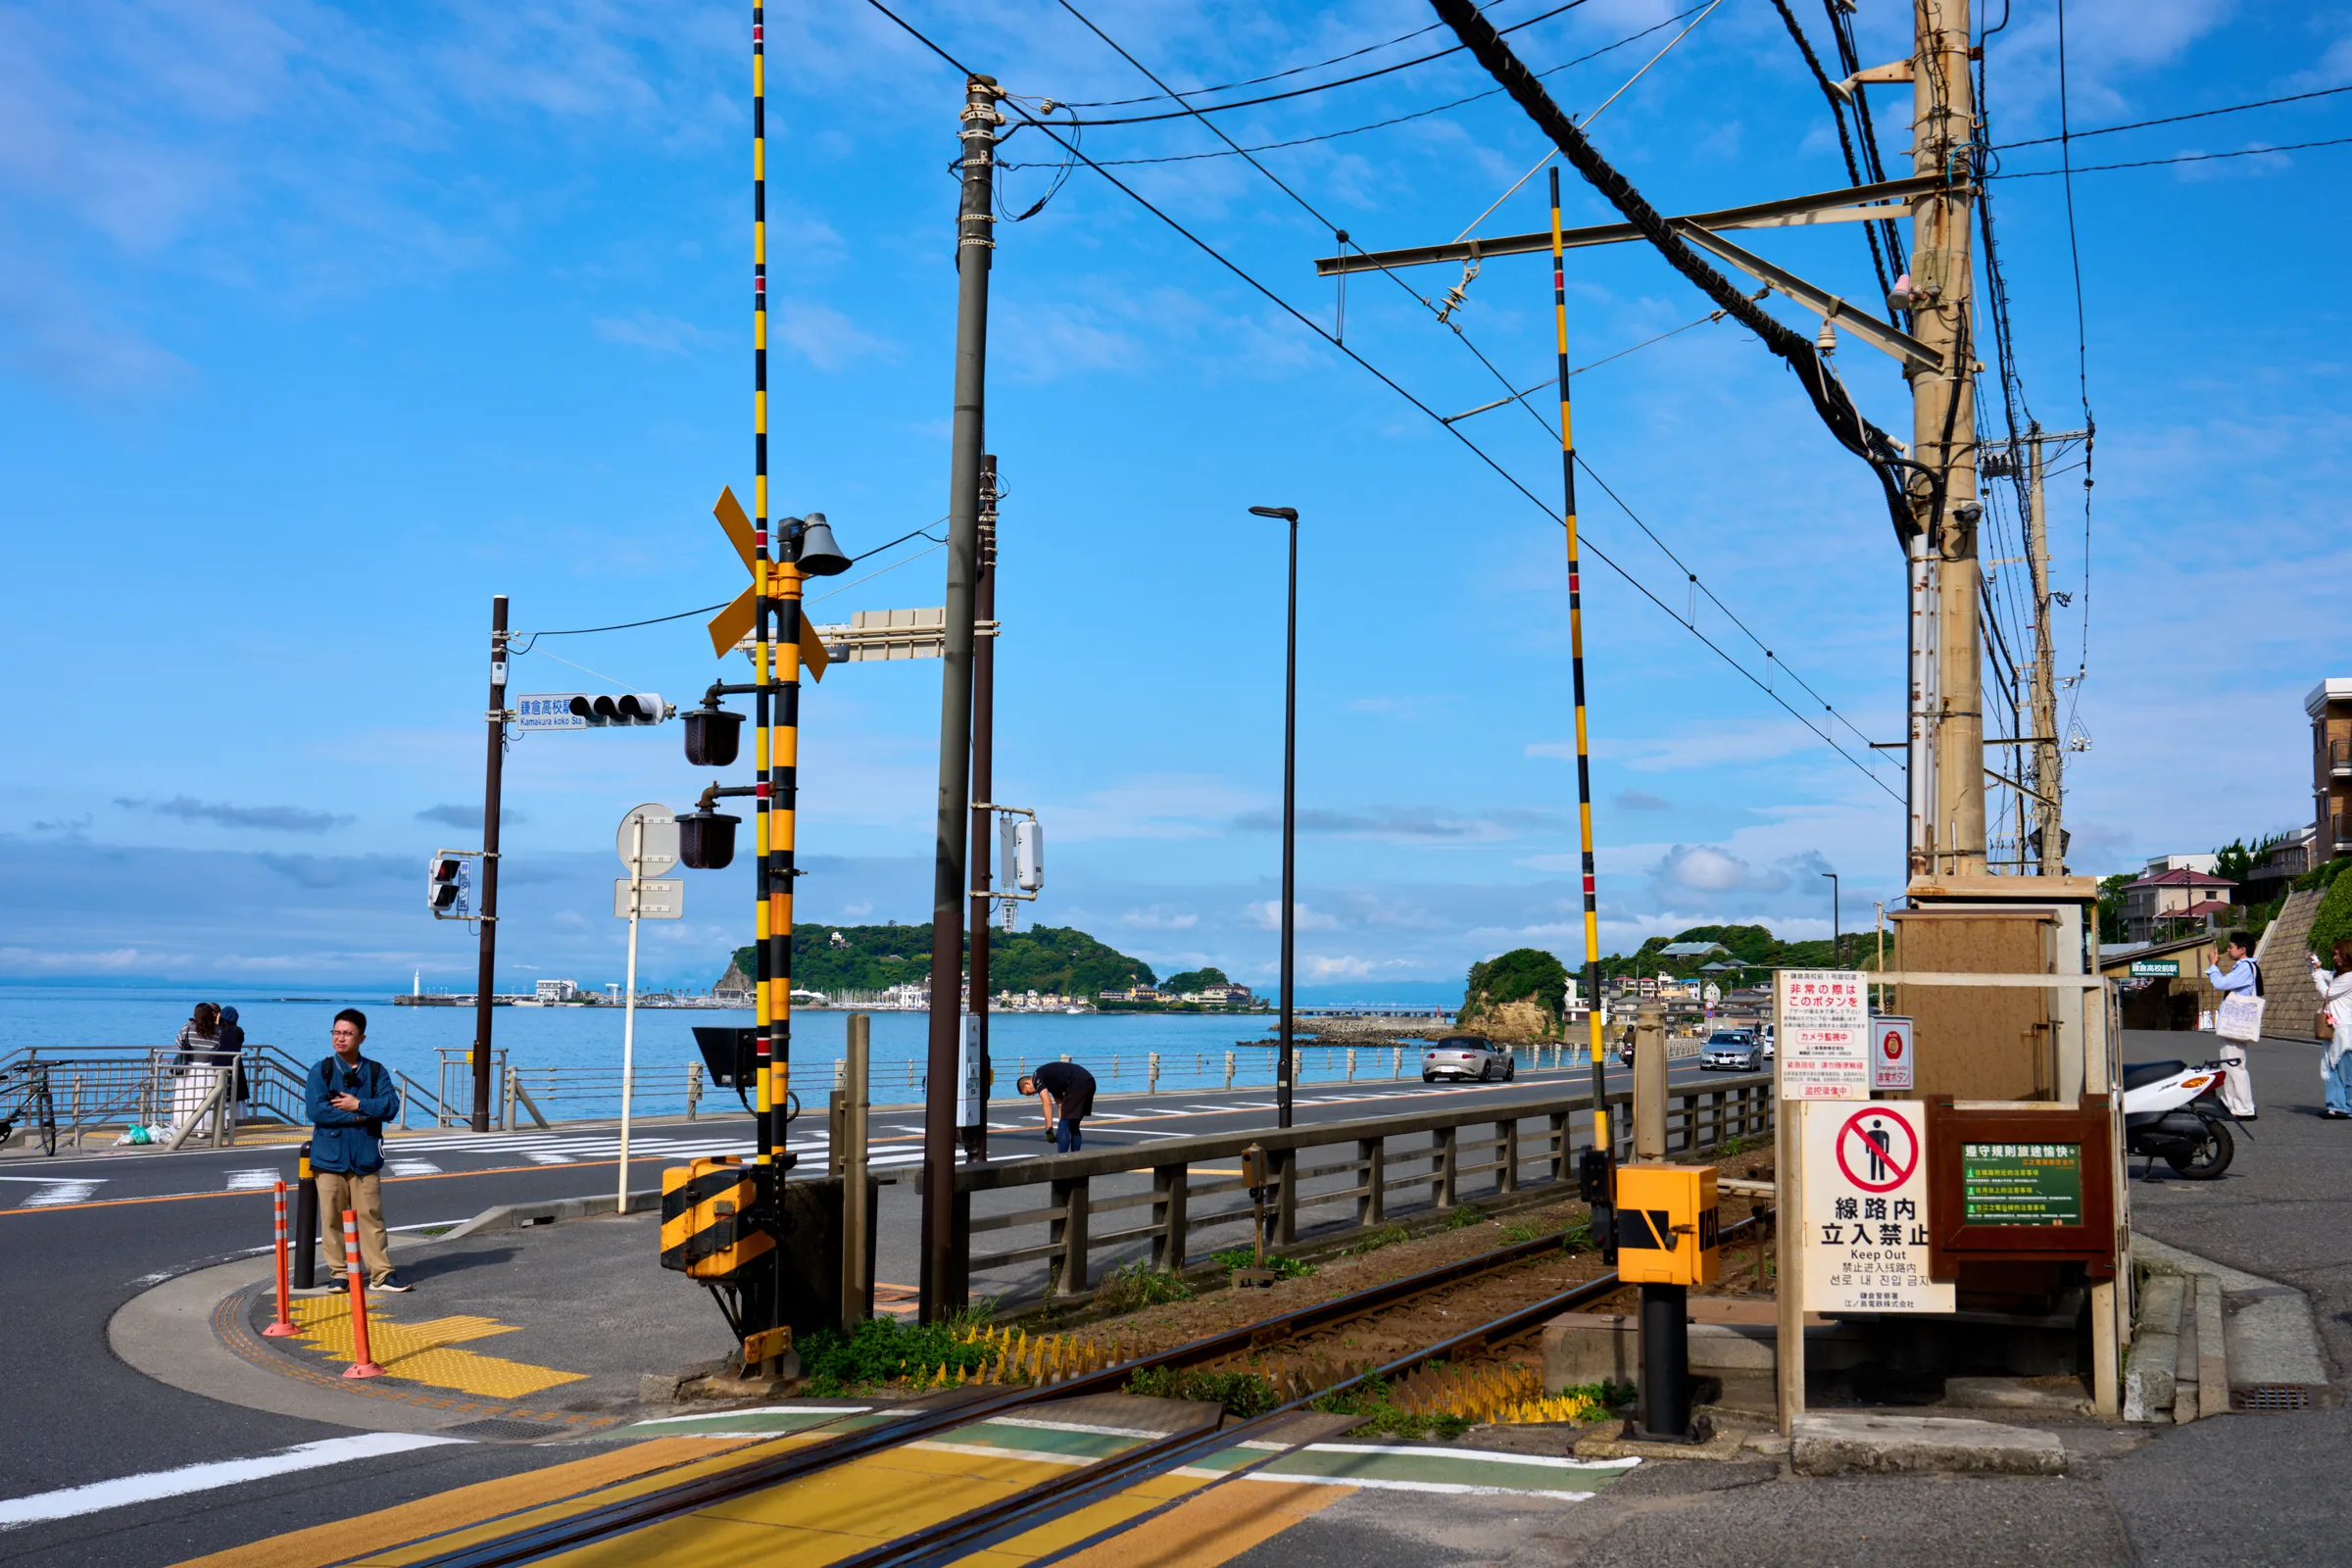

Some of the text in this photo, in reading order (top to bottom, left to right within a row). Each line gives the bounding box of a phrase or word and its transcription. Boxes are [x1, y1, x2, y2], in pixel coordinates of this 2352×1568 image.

[520, 700, 571, 714] 鎌倉高校駅
[1790, 984, 1856, 995] 非常の際は
[1789, 997, 1858, 1007] このボタンを
[1878, 1072, 1909, 1083] 非常ボタン
[1805, 1086, 1847, 1095] 监控录像中
[1965, 1145, 2076, 1157] 遵守規則旅途愉快。
[1836, 1198, 1915, 1220] 線路内
[1821, 1223, 1930, 1246] 立入禁止
[1851, 1250, 1906, 1261] Keep Out
[1842, 1262, 1916, 1273] 禁止进入线路内
[1830, 1275, 1852, 1286] 선로
[1860, 1275, 1871, 1286] 내
[1880, 1275, 1901, 1286] 진입
